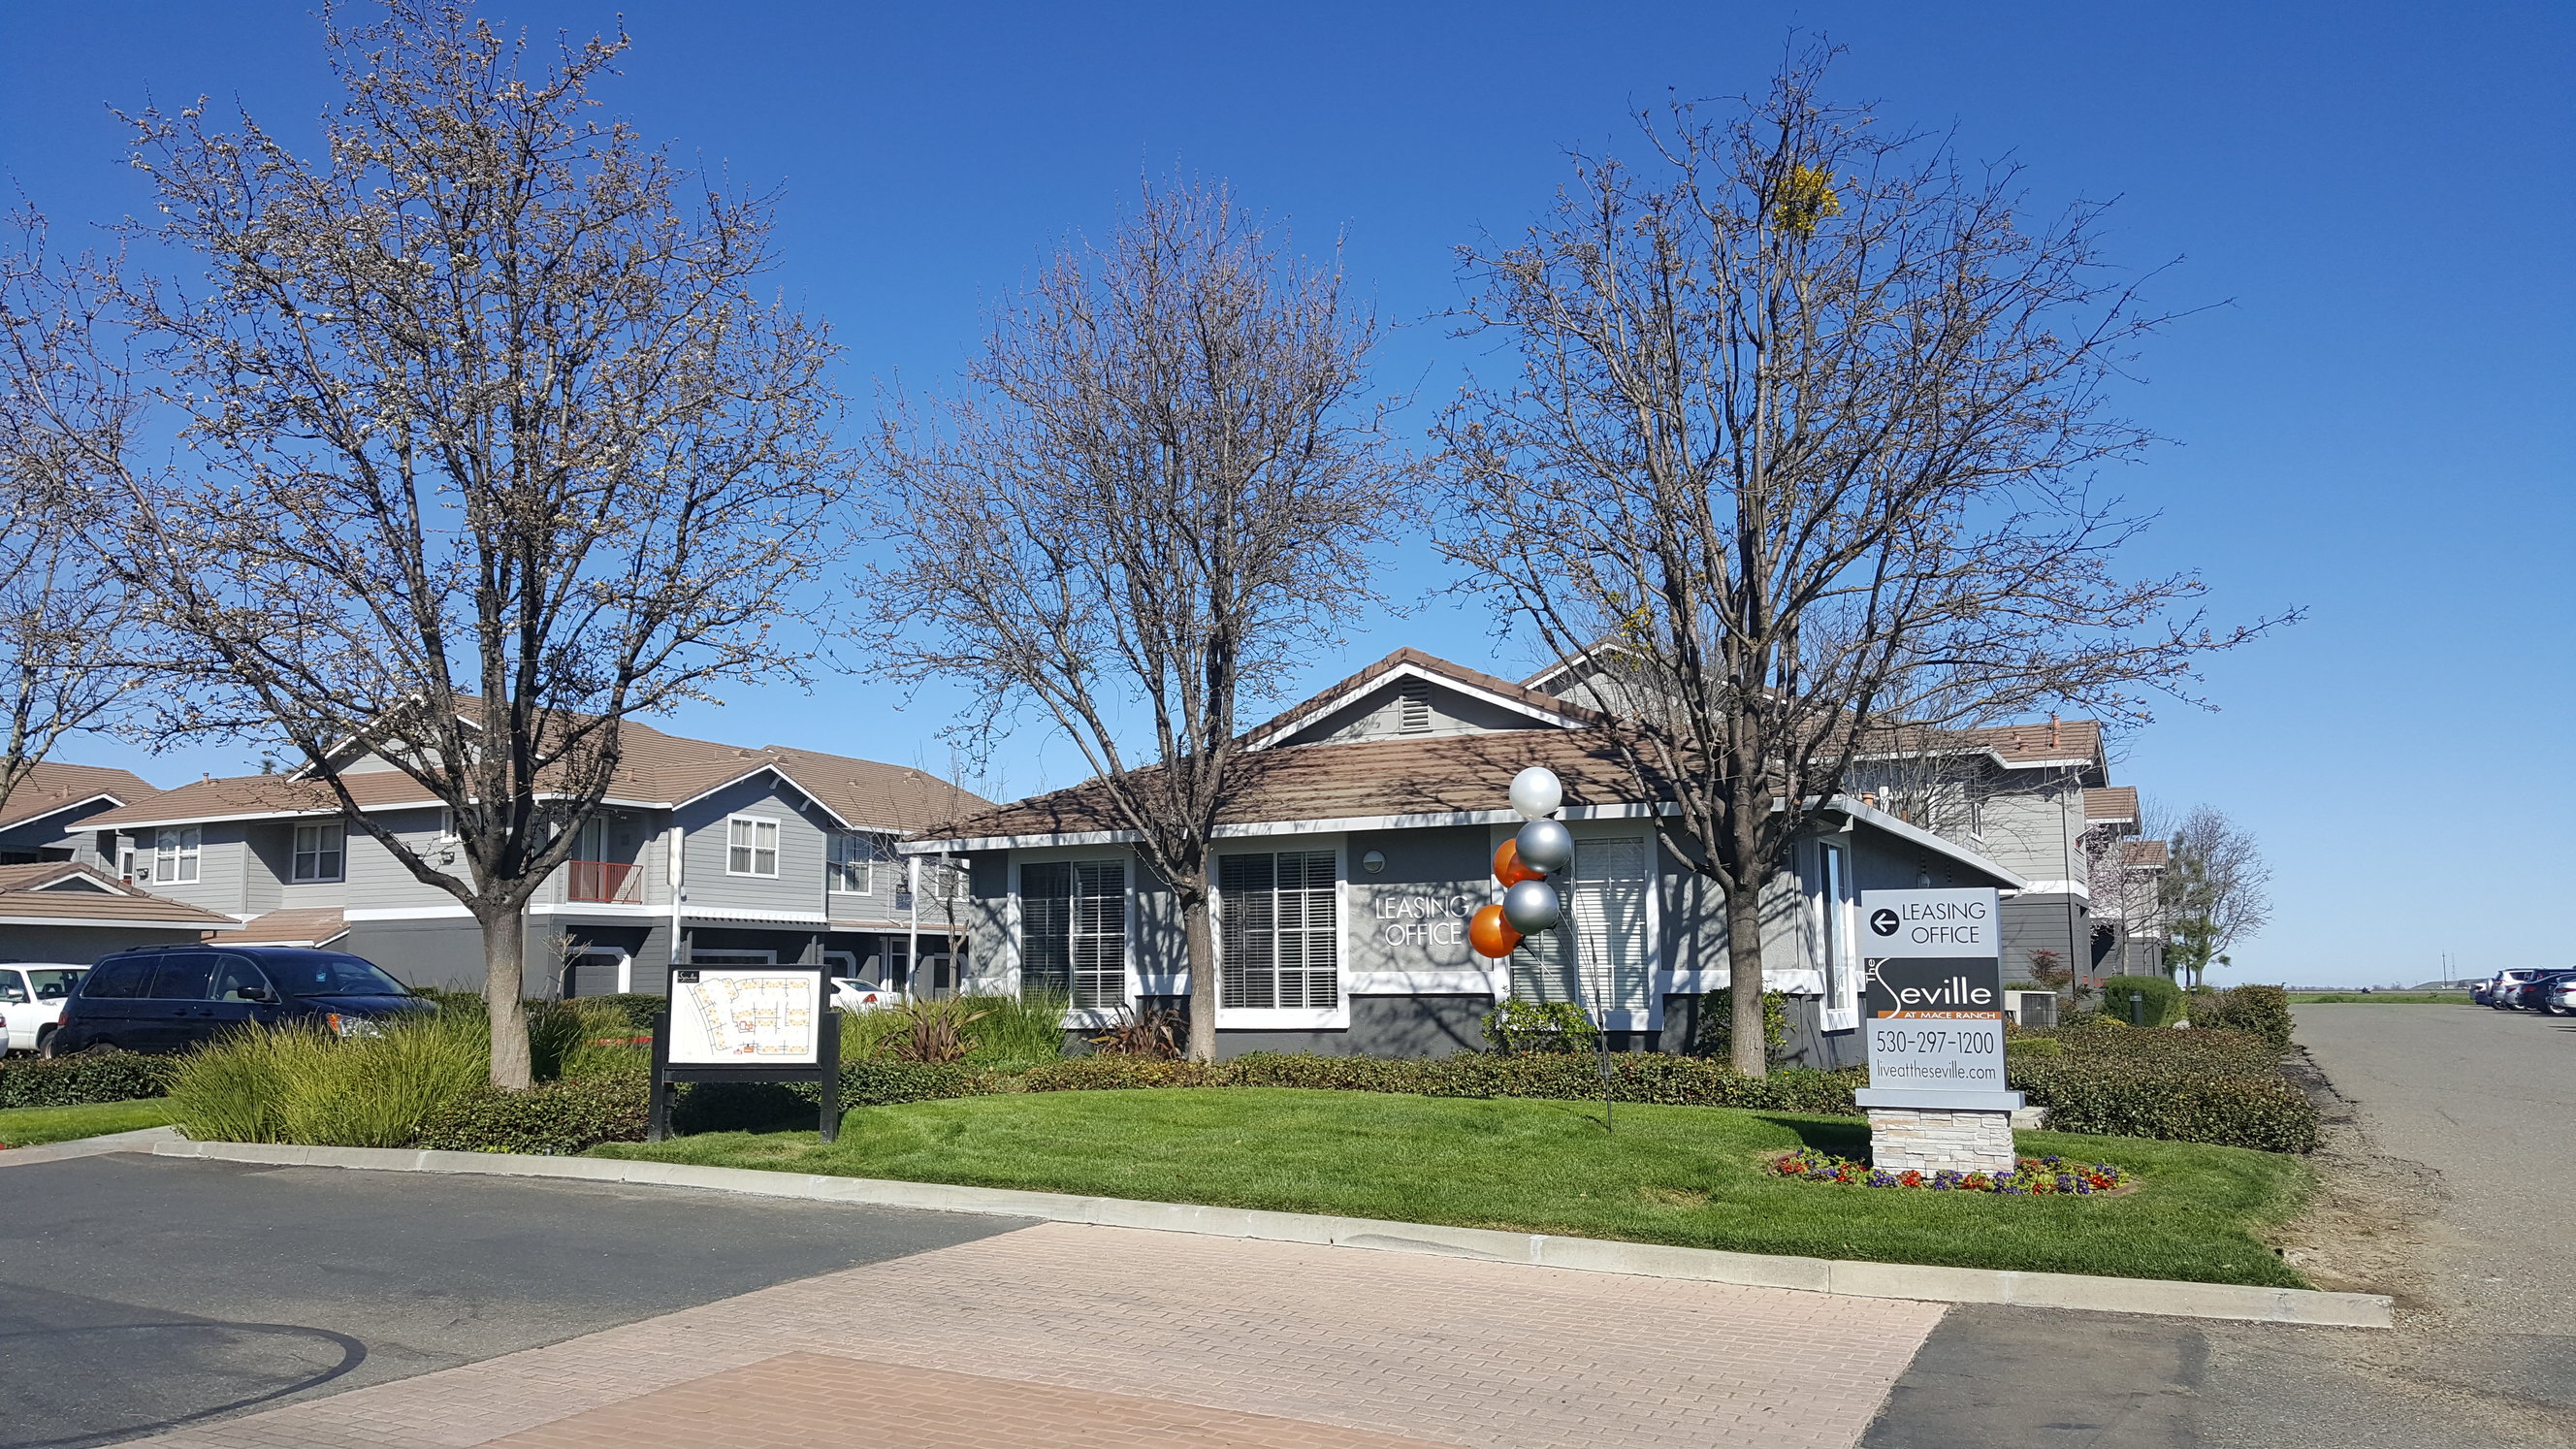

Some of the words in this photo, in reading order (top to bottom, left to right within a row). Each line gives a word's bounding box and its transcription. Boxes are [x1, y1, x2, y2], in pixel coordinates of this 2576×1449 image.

[1375, 895, 1469, 918] LEASING
[1902, 902, 1986, 920] LEASING
[1385, 922, 1462, 946] OFFICE
[1911, 926, 1980, 944] OFFICE
[1865, 958, 1876, 983] The
[1875, 957, 1992, 1019] Seville
[1877, 1030, 1994, 1054] 530-297-1200
[1877, 1059, 1996, 1079] liveattheseville.com
